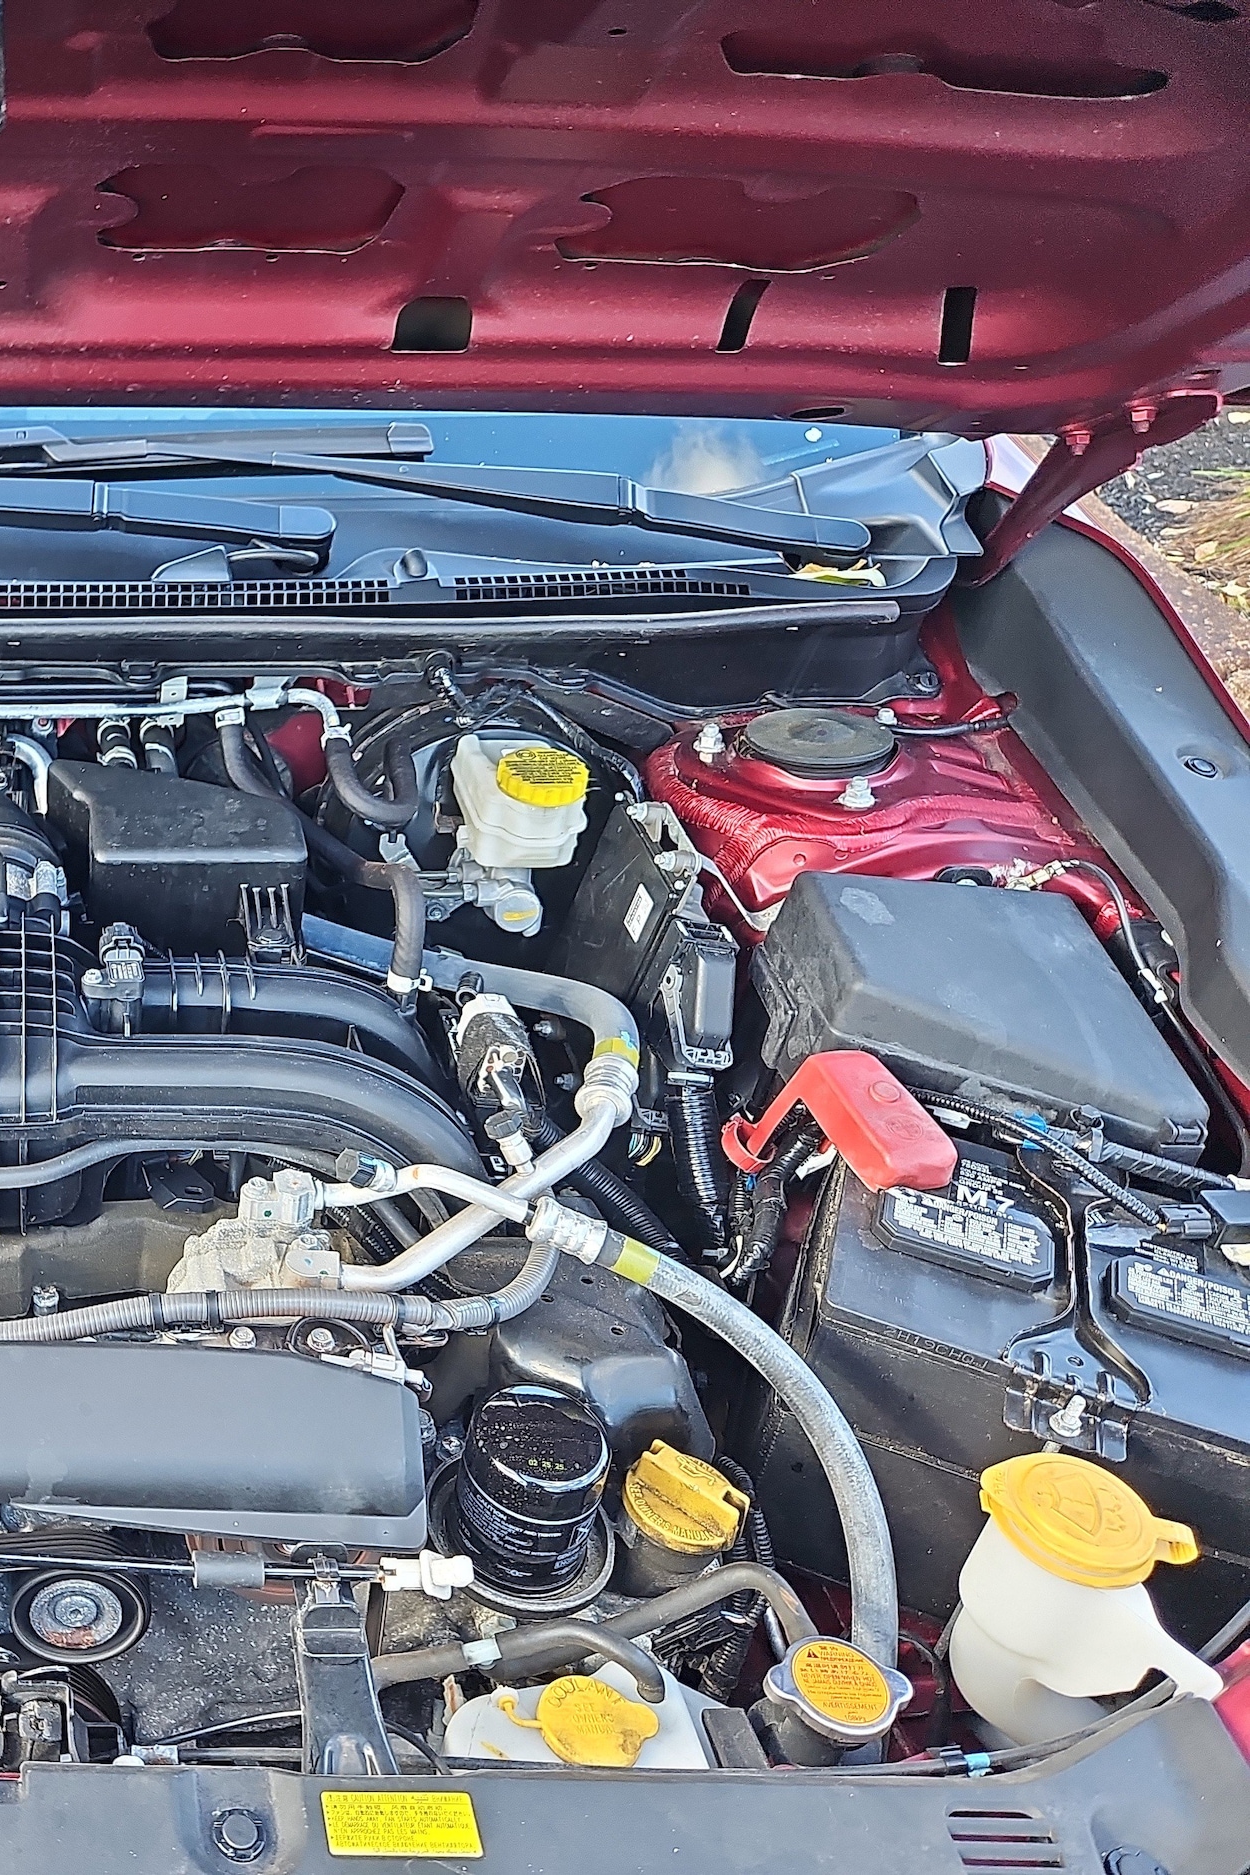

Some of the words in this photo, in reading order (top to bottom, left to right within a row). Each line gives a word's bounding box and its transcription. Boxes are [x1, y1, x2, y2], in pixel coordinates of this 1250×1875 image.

[1169, 1269, 1241, 1299] DANGER/POISON
[629, 1483, 645, 1499] SEE
[476, 1494, 508, 1521] CAUTION
[635, 1498, 671, 1531] OWNER'S
[672, 1526, 715, 1541] MANUAL
[547, 1678, 626, 1708] COOLANT
[573, 1703, 595, 1712] SEE
[822, 1701, 878, 1711] AVERTISSEMENT
[350, 1794, 375, 1803] CAUTION
[377, 1794, 408, 1803] ATTENTION
